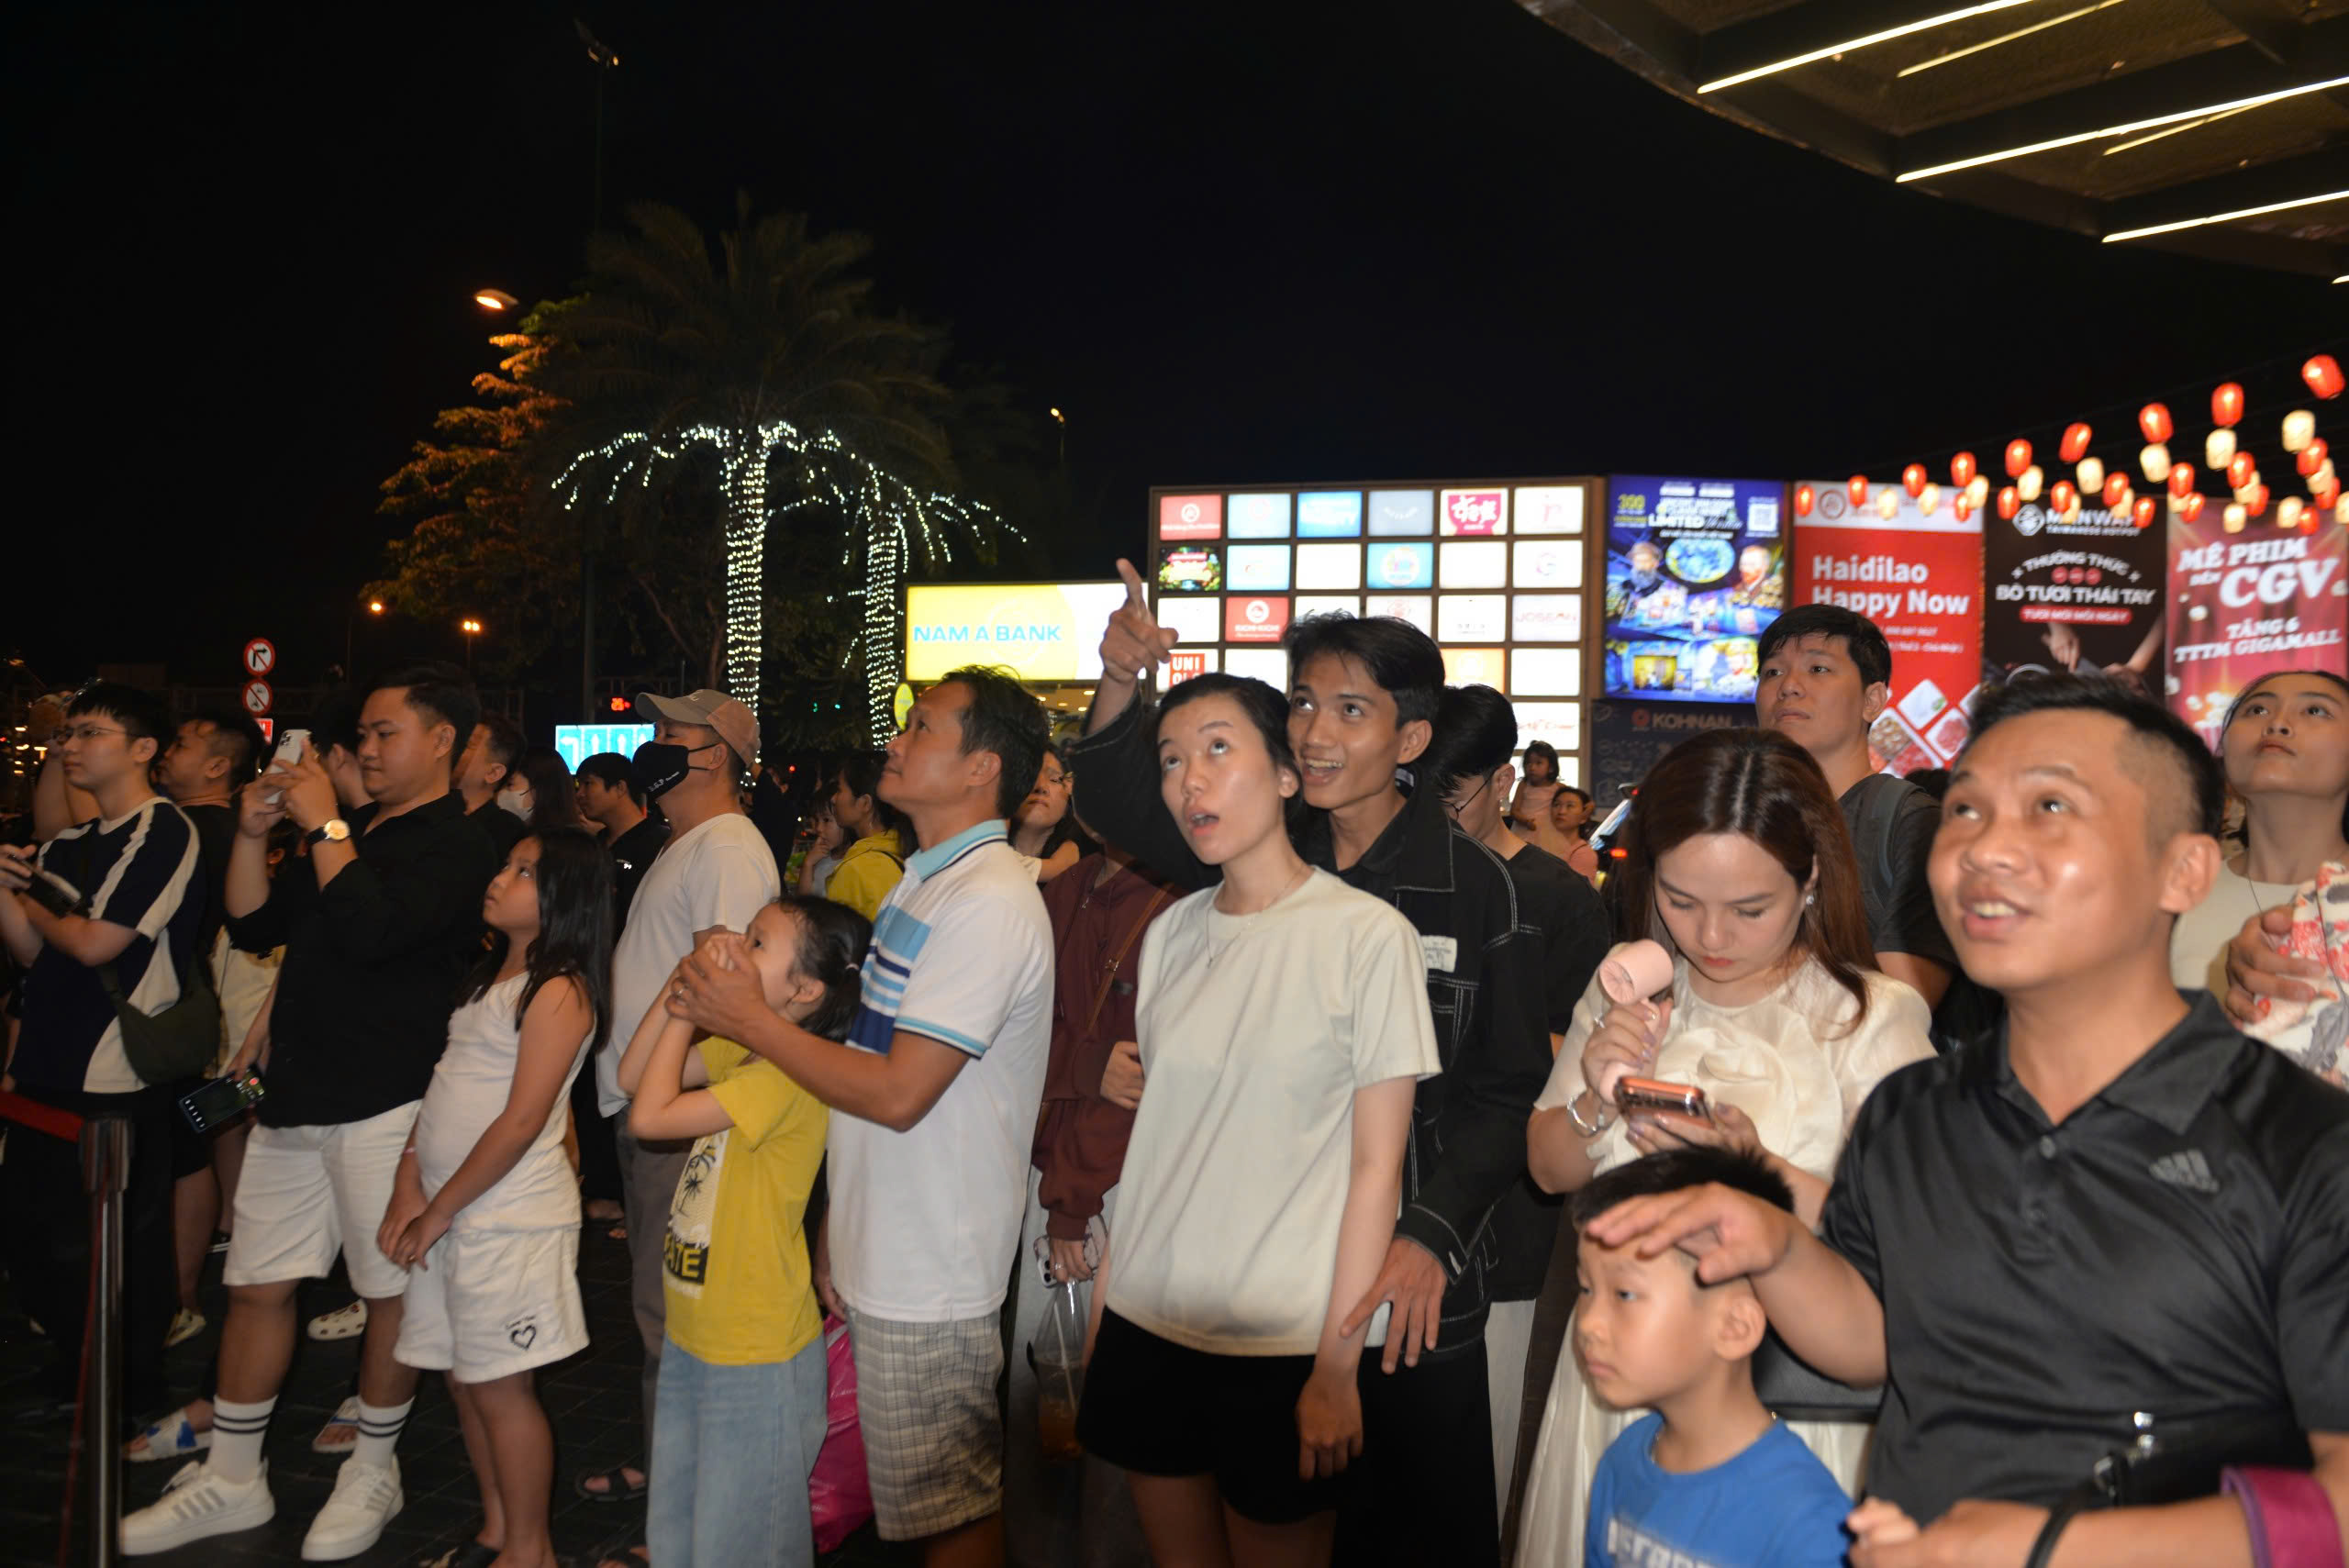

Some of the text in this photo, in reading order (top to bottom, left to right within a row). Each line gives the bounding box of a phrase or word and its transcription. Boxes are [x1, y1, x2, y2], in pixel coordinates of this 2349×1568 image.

[2227, 537, 2308, 566] PHIM
[1812, 554, 1929, 583] Haidilao
[2219, 558, 2339, 608] CGV
[1811, 585, 1970, 618] Happy Now
[914, 625, 1062, 641] NAM A BANK
[2233, 628, 2342, 655] GIGAMALL
[1173, 657, 1200, 671] UNI
[1652, 713, 1733, 728] KOHNAN
